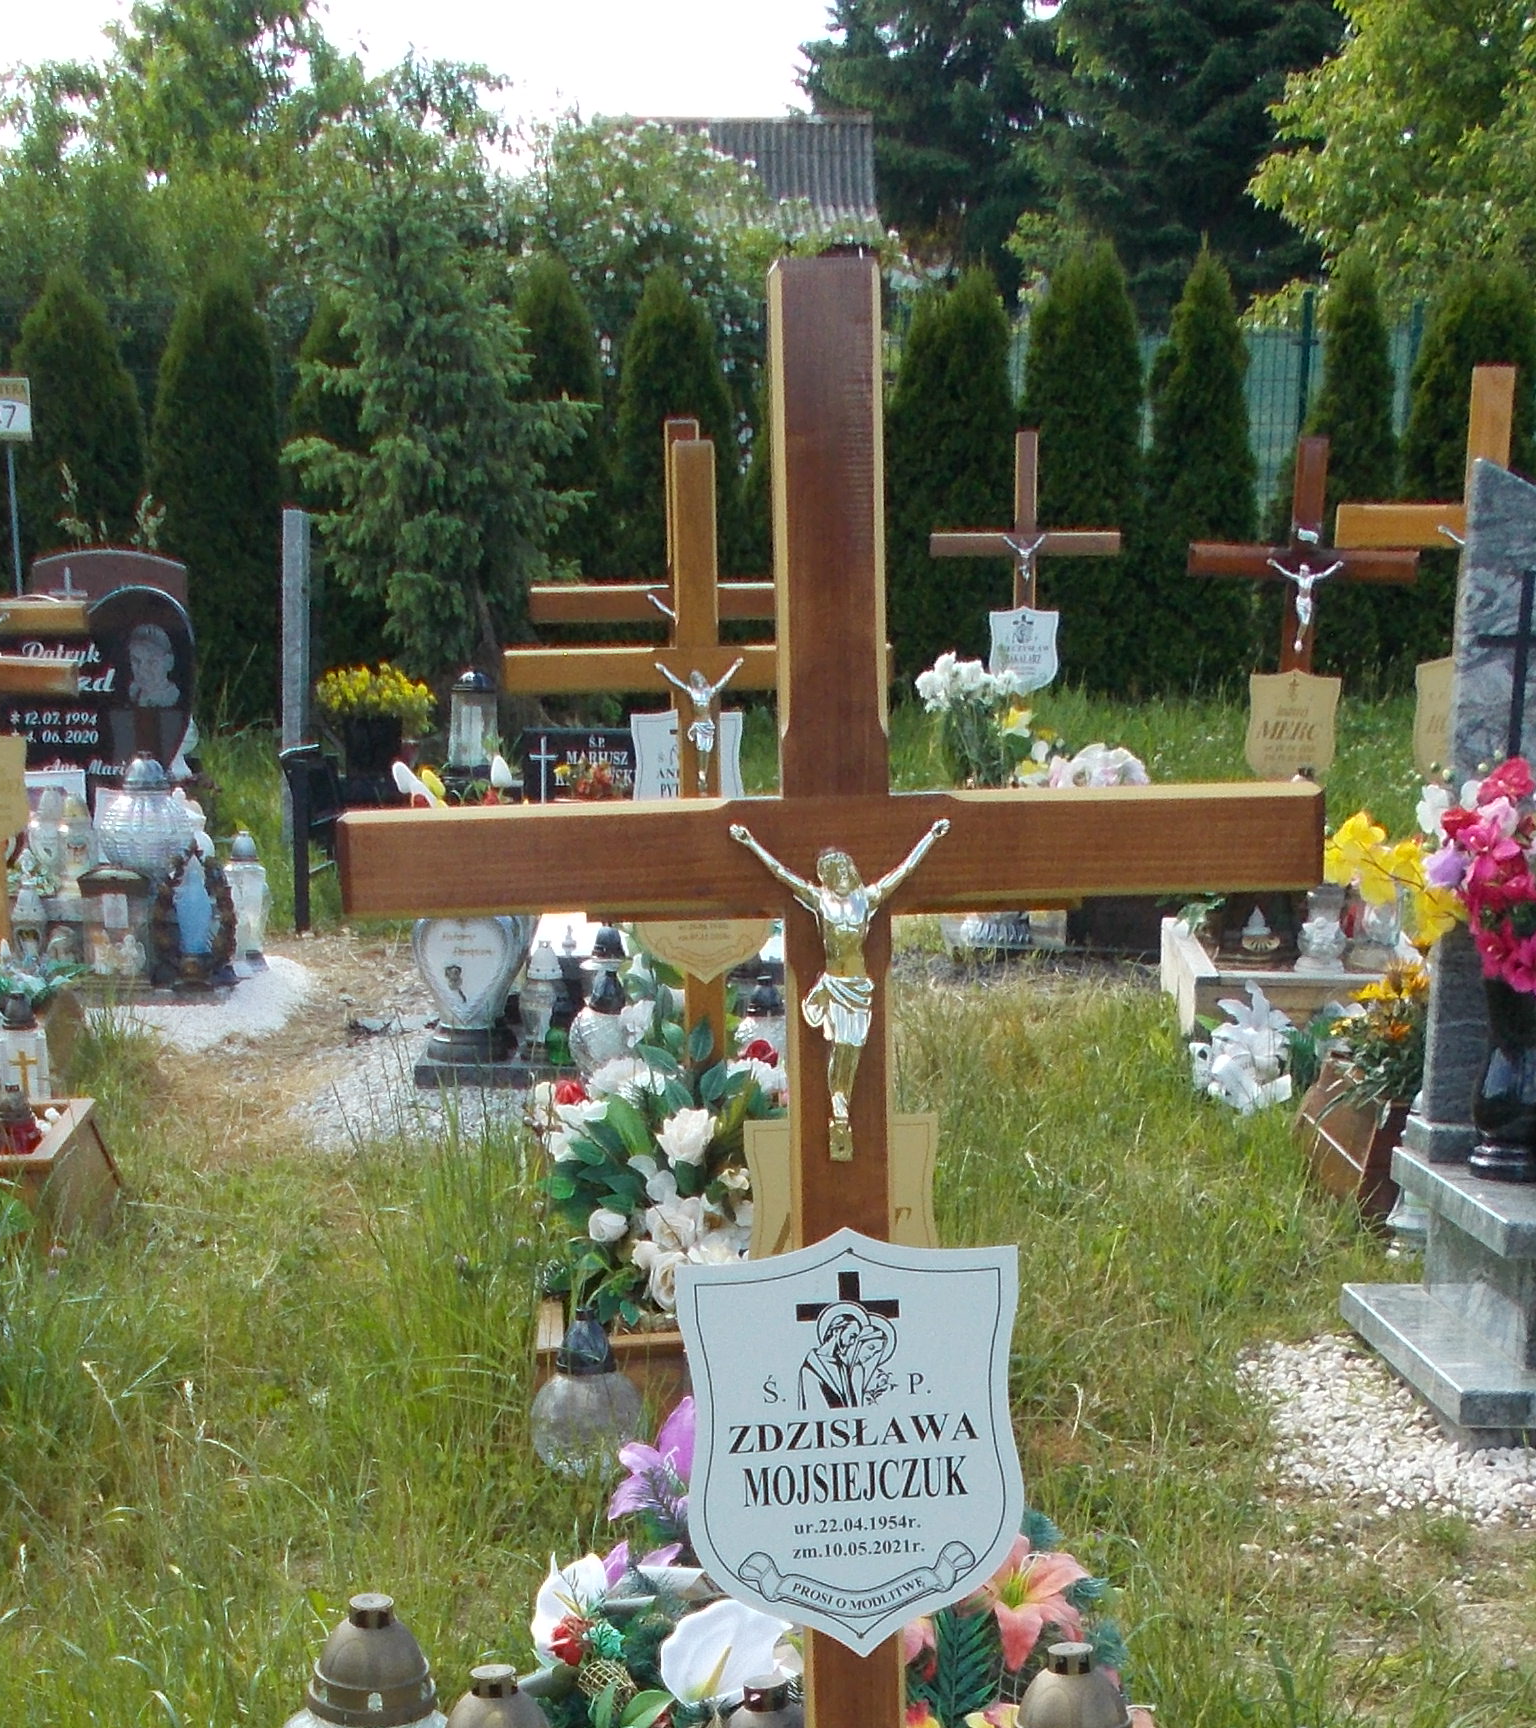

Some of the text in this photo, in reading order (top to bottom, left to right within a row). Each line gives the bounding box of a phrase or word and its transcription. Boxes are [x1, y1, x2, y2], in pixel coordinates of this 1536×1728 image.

[88, 759, 127, 776] Mari
[763, 1372, 932, 1404] Ś. P.
[728, 1412, 980, 1455] ZDZISŁAWA
[742, 1455, 969, 1508] MOJSIEJCZUK
[794, 1515, 922, 1535] ur.22.04.1954r.
[792, 1539, 926, 1560] zm.10.05.2021r.
[791, 1574, 927, 1611] PROSI O MODLITWĘ
